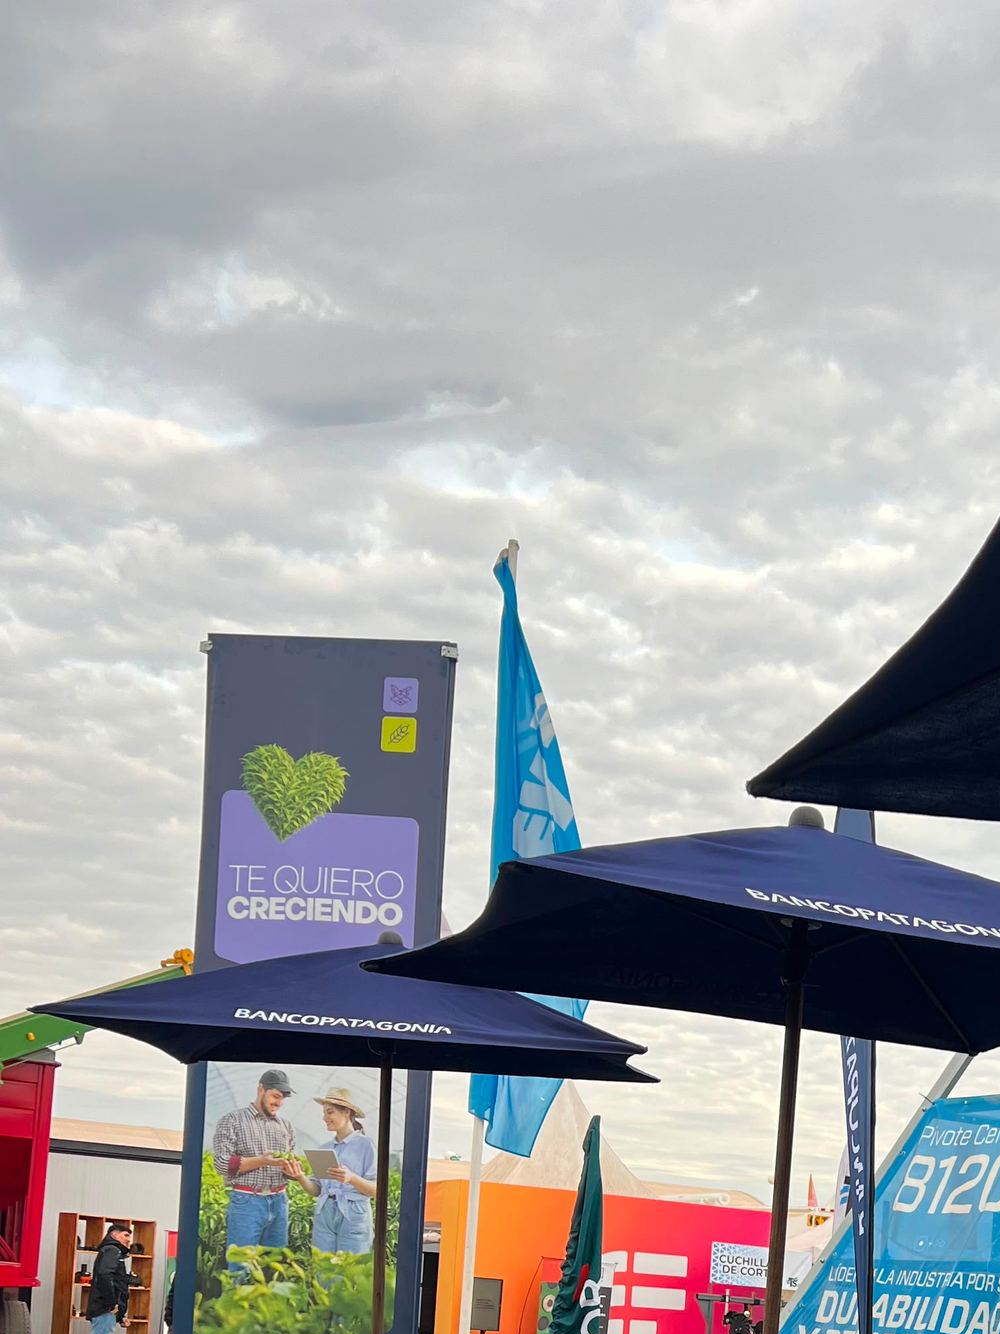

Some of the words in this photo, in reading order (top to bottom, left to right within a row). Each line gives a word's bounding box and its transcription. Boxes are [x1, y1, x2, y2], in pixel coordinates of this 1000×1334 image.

[229, 865, 266, 892] TE
[273, 865, 404, 899] QUIERO
[227, 896, 403, 926] CRECIENDO
[233, 1008, 452, 1036] BANCOPATAGONIA
[921, 1125, 971, 1147] Pivote
[719, 1254, 769, 1268] CUCHILL
[722, 1265, 737, 1275] DE
[828, 1265, 857, 1282] LÍDE
[876, 1269, 895, 1285] LA
[895, 1270, 963, 1290] INDUSTRA
[966, 1273, 995, 1292] POR
